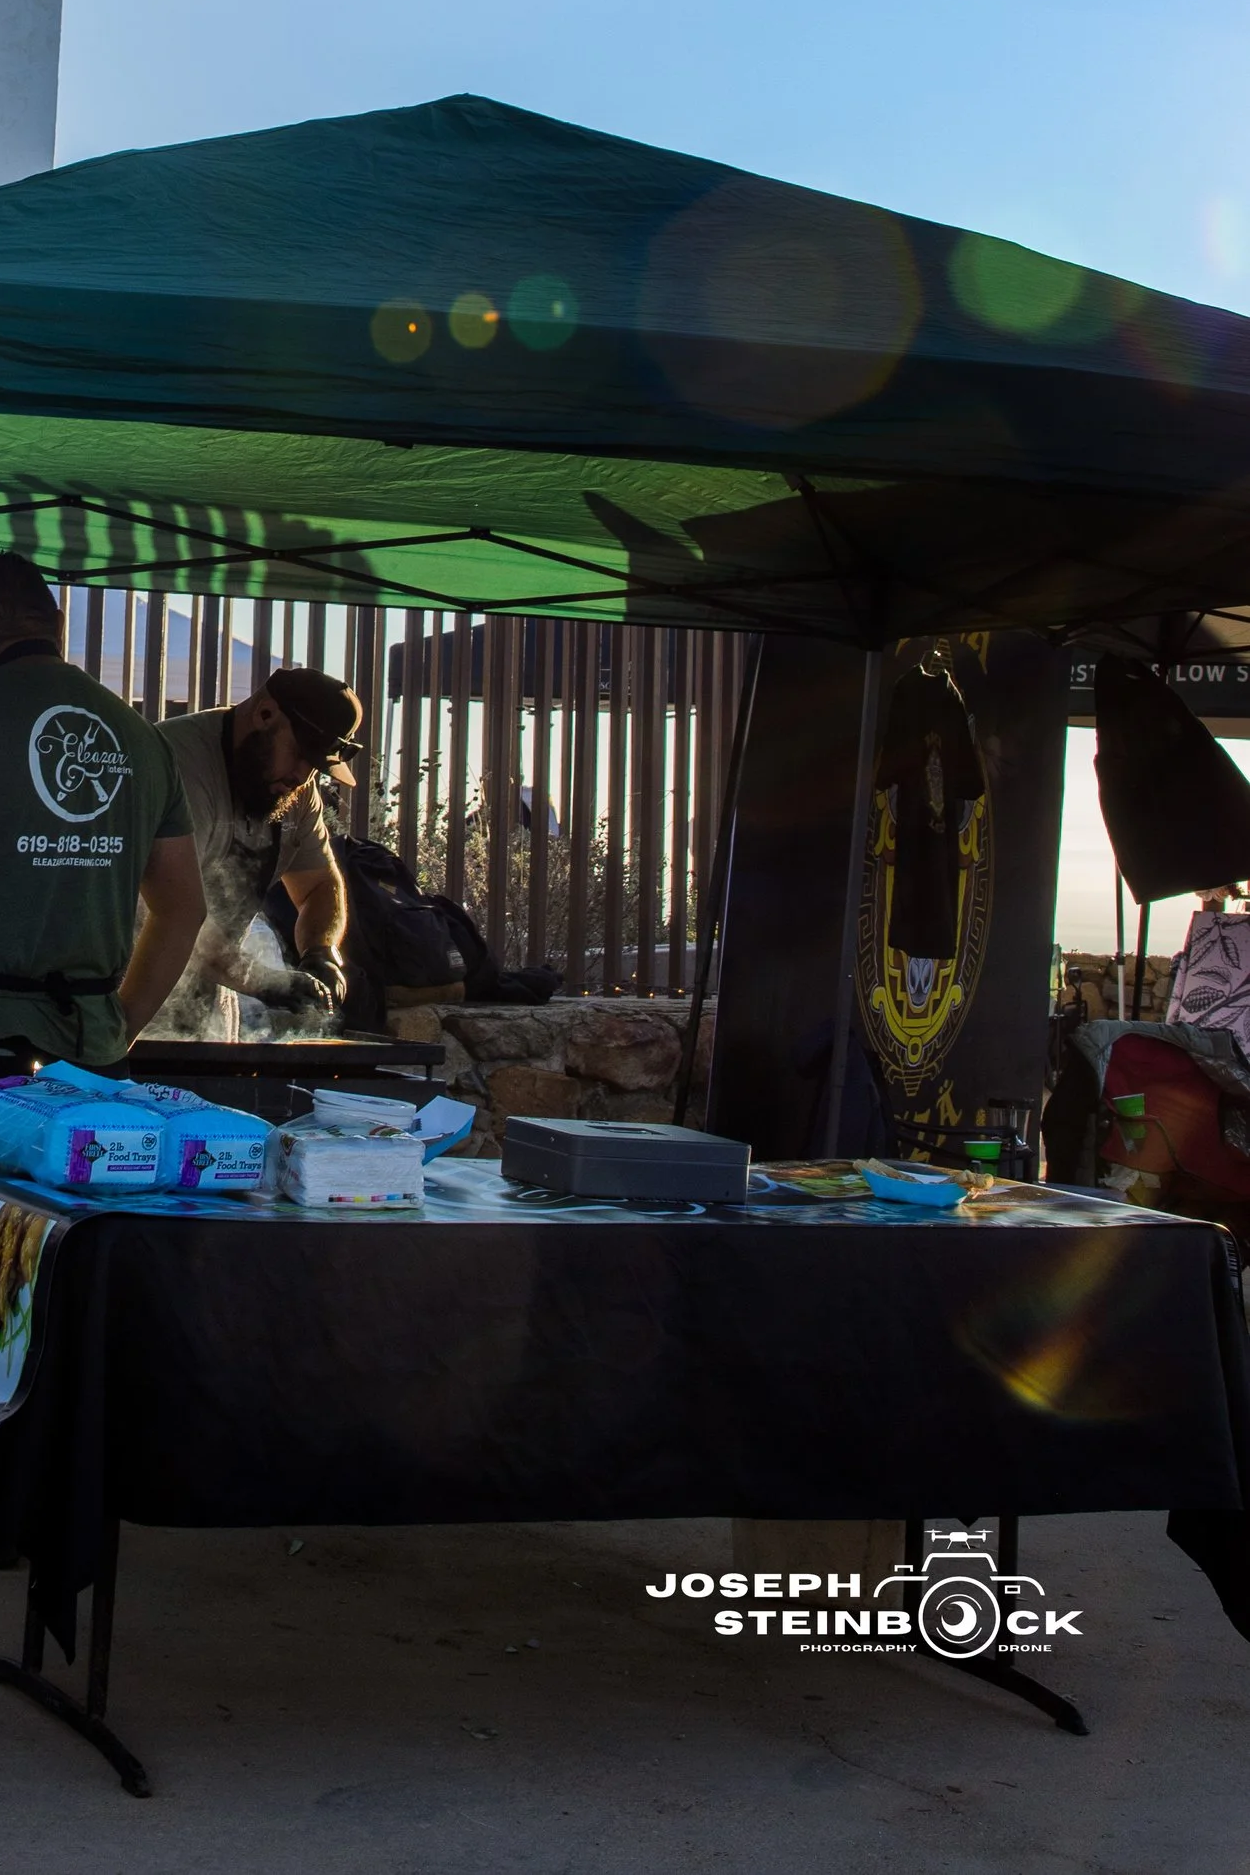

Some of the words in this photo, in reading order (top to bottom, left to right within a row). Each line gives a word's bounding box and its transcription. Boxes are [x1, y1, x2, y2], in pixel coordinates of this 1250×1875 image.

[37, 732, 129, 793] Eleazar
[110, 1142, 116, 1151] 2
[116, 1142, 125, 1151] lb
[108, 1152, 130, 1162] Food
[132, 1152, 157, 1163] Trays
[218, 1151, 224, 1161] 2
[225, 1151, 233, 1161] lb
[216, 1160, 238, 1170] Food
[239, 1161, 262, 1172] Trays
